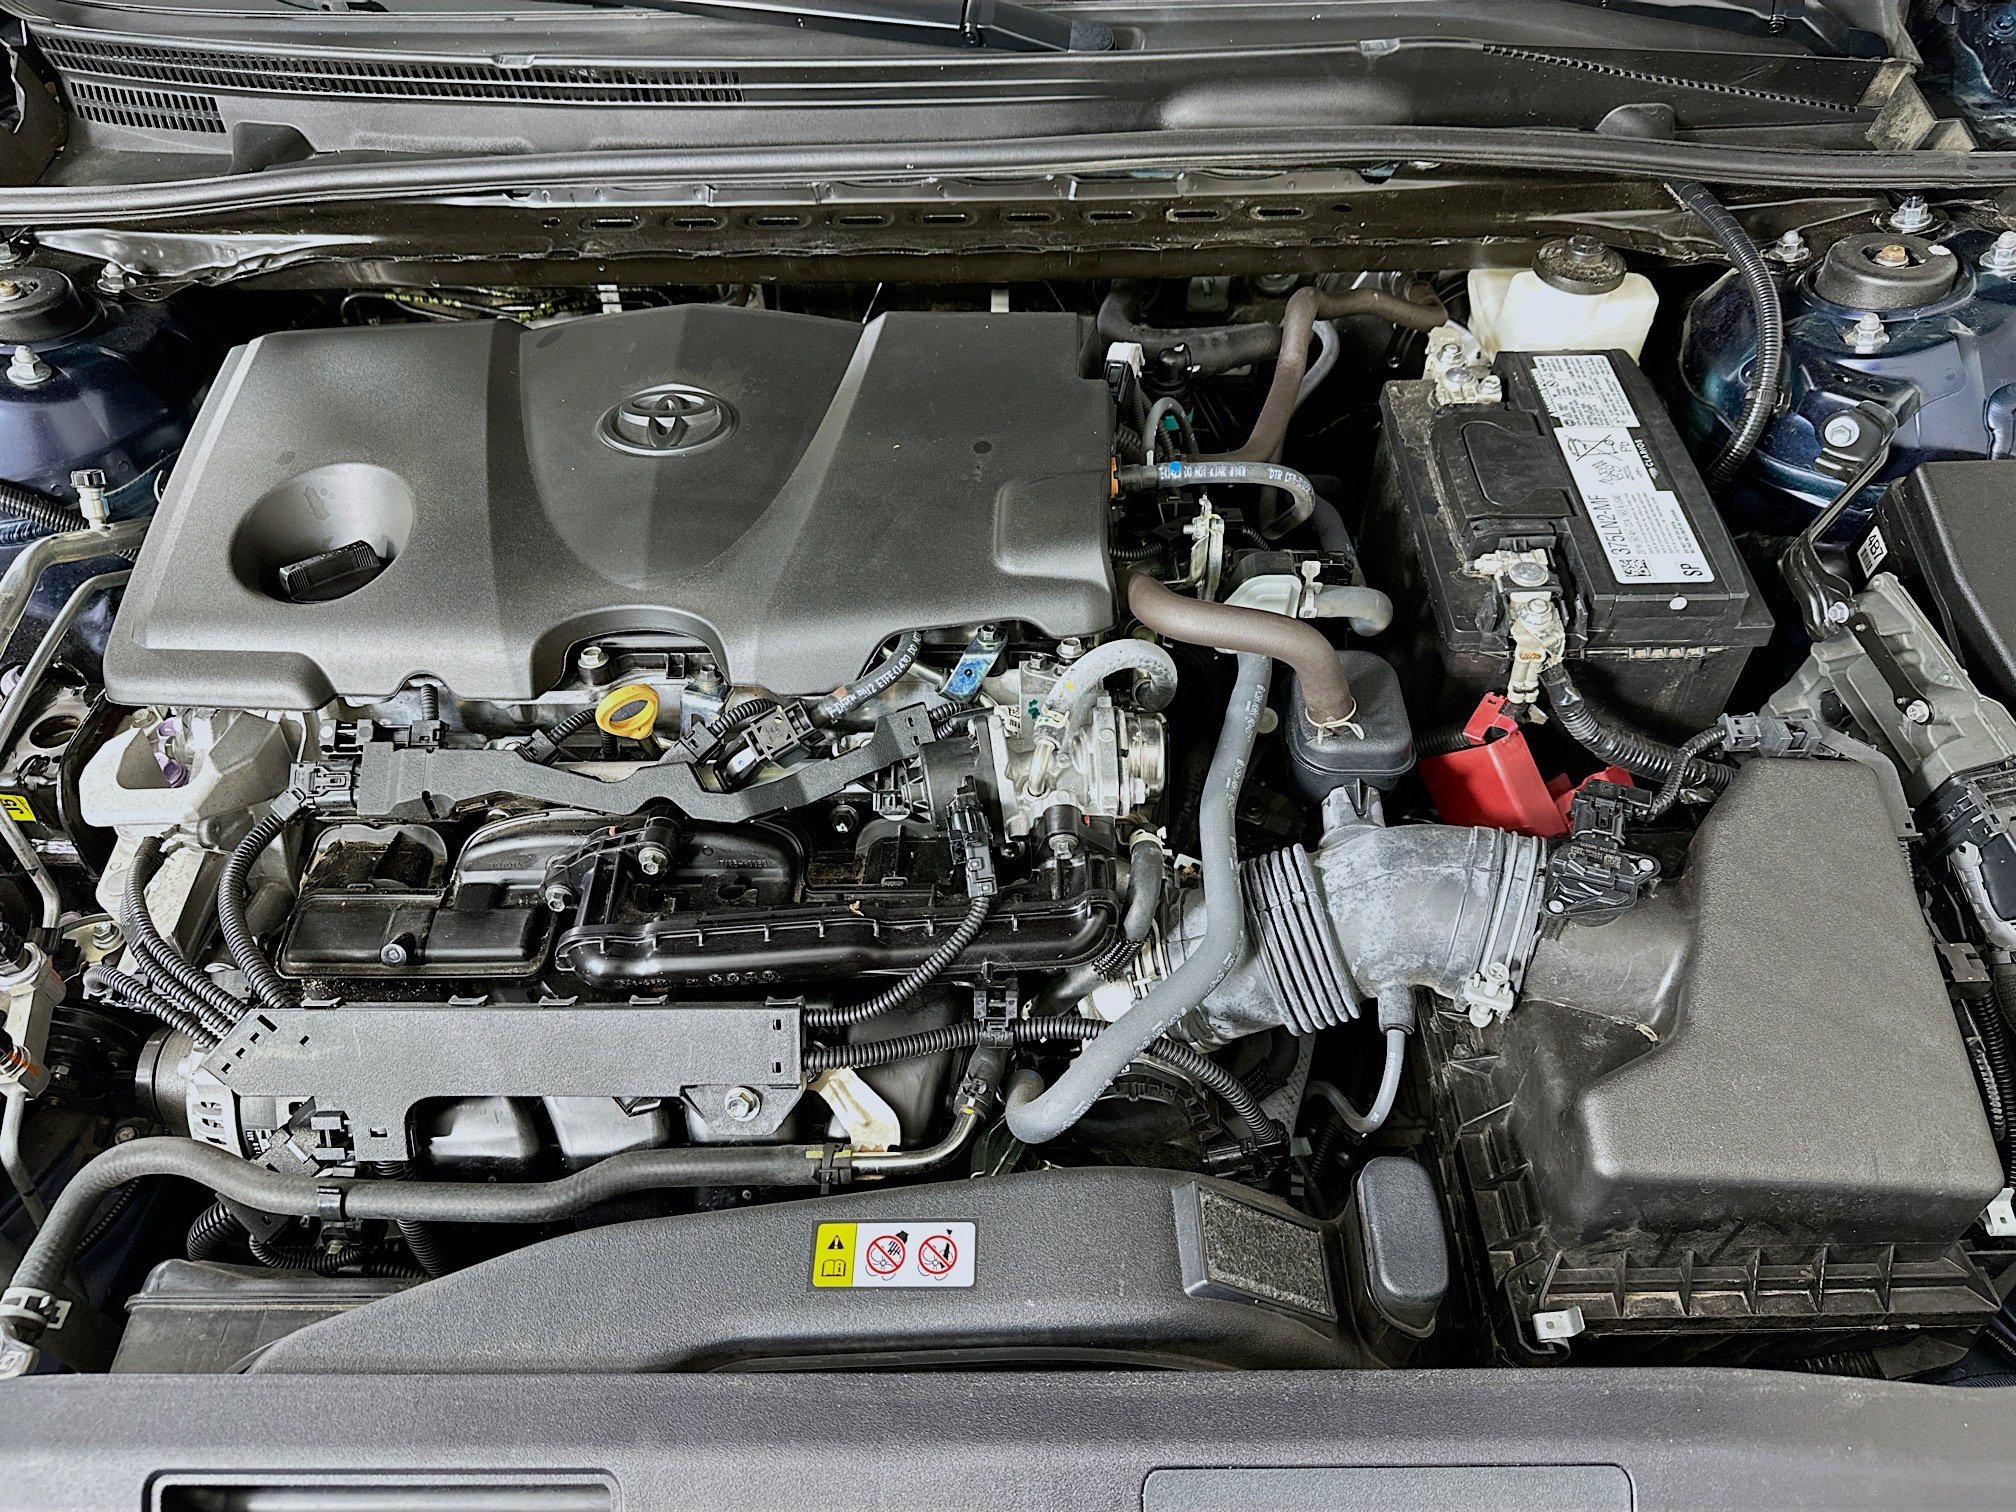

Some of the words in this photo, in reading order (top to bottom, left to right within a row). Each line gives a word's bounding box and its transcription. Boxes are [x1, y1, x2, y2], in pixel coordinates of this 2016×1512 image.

[1620, 441, 1633, 452] Pb
[1634, 439, 1655, 467] CLARIOS
[1588, 495, 1631, 555] 375LN2-MF
[1868, 534, 1884, 561] 4B7
[1680, 563, 1703, 577] SP
[908, 643, 918, 656] DO
